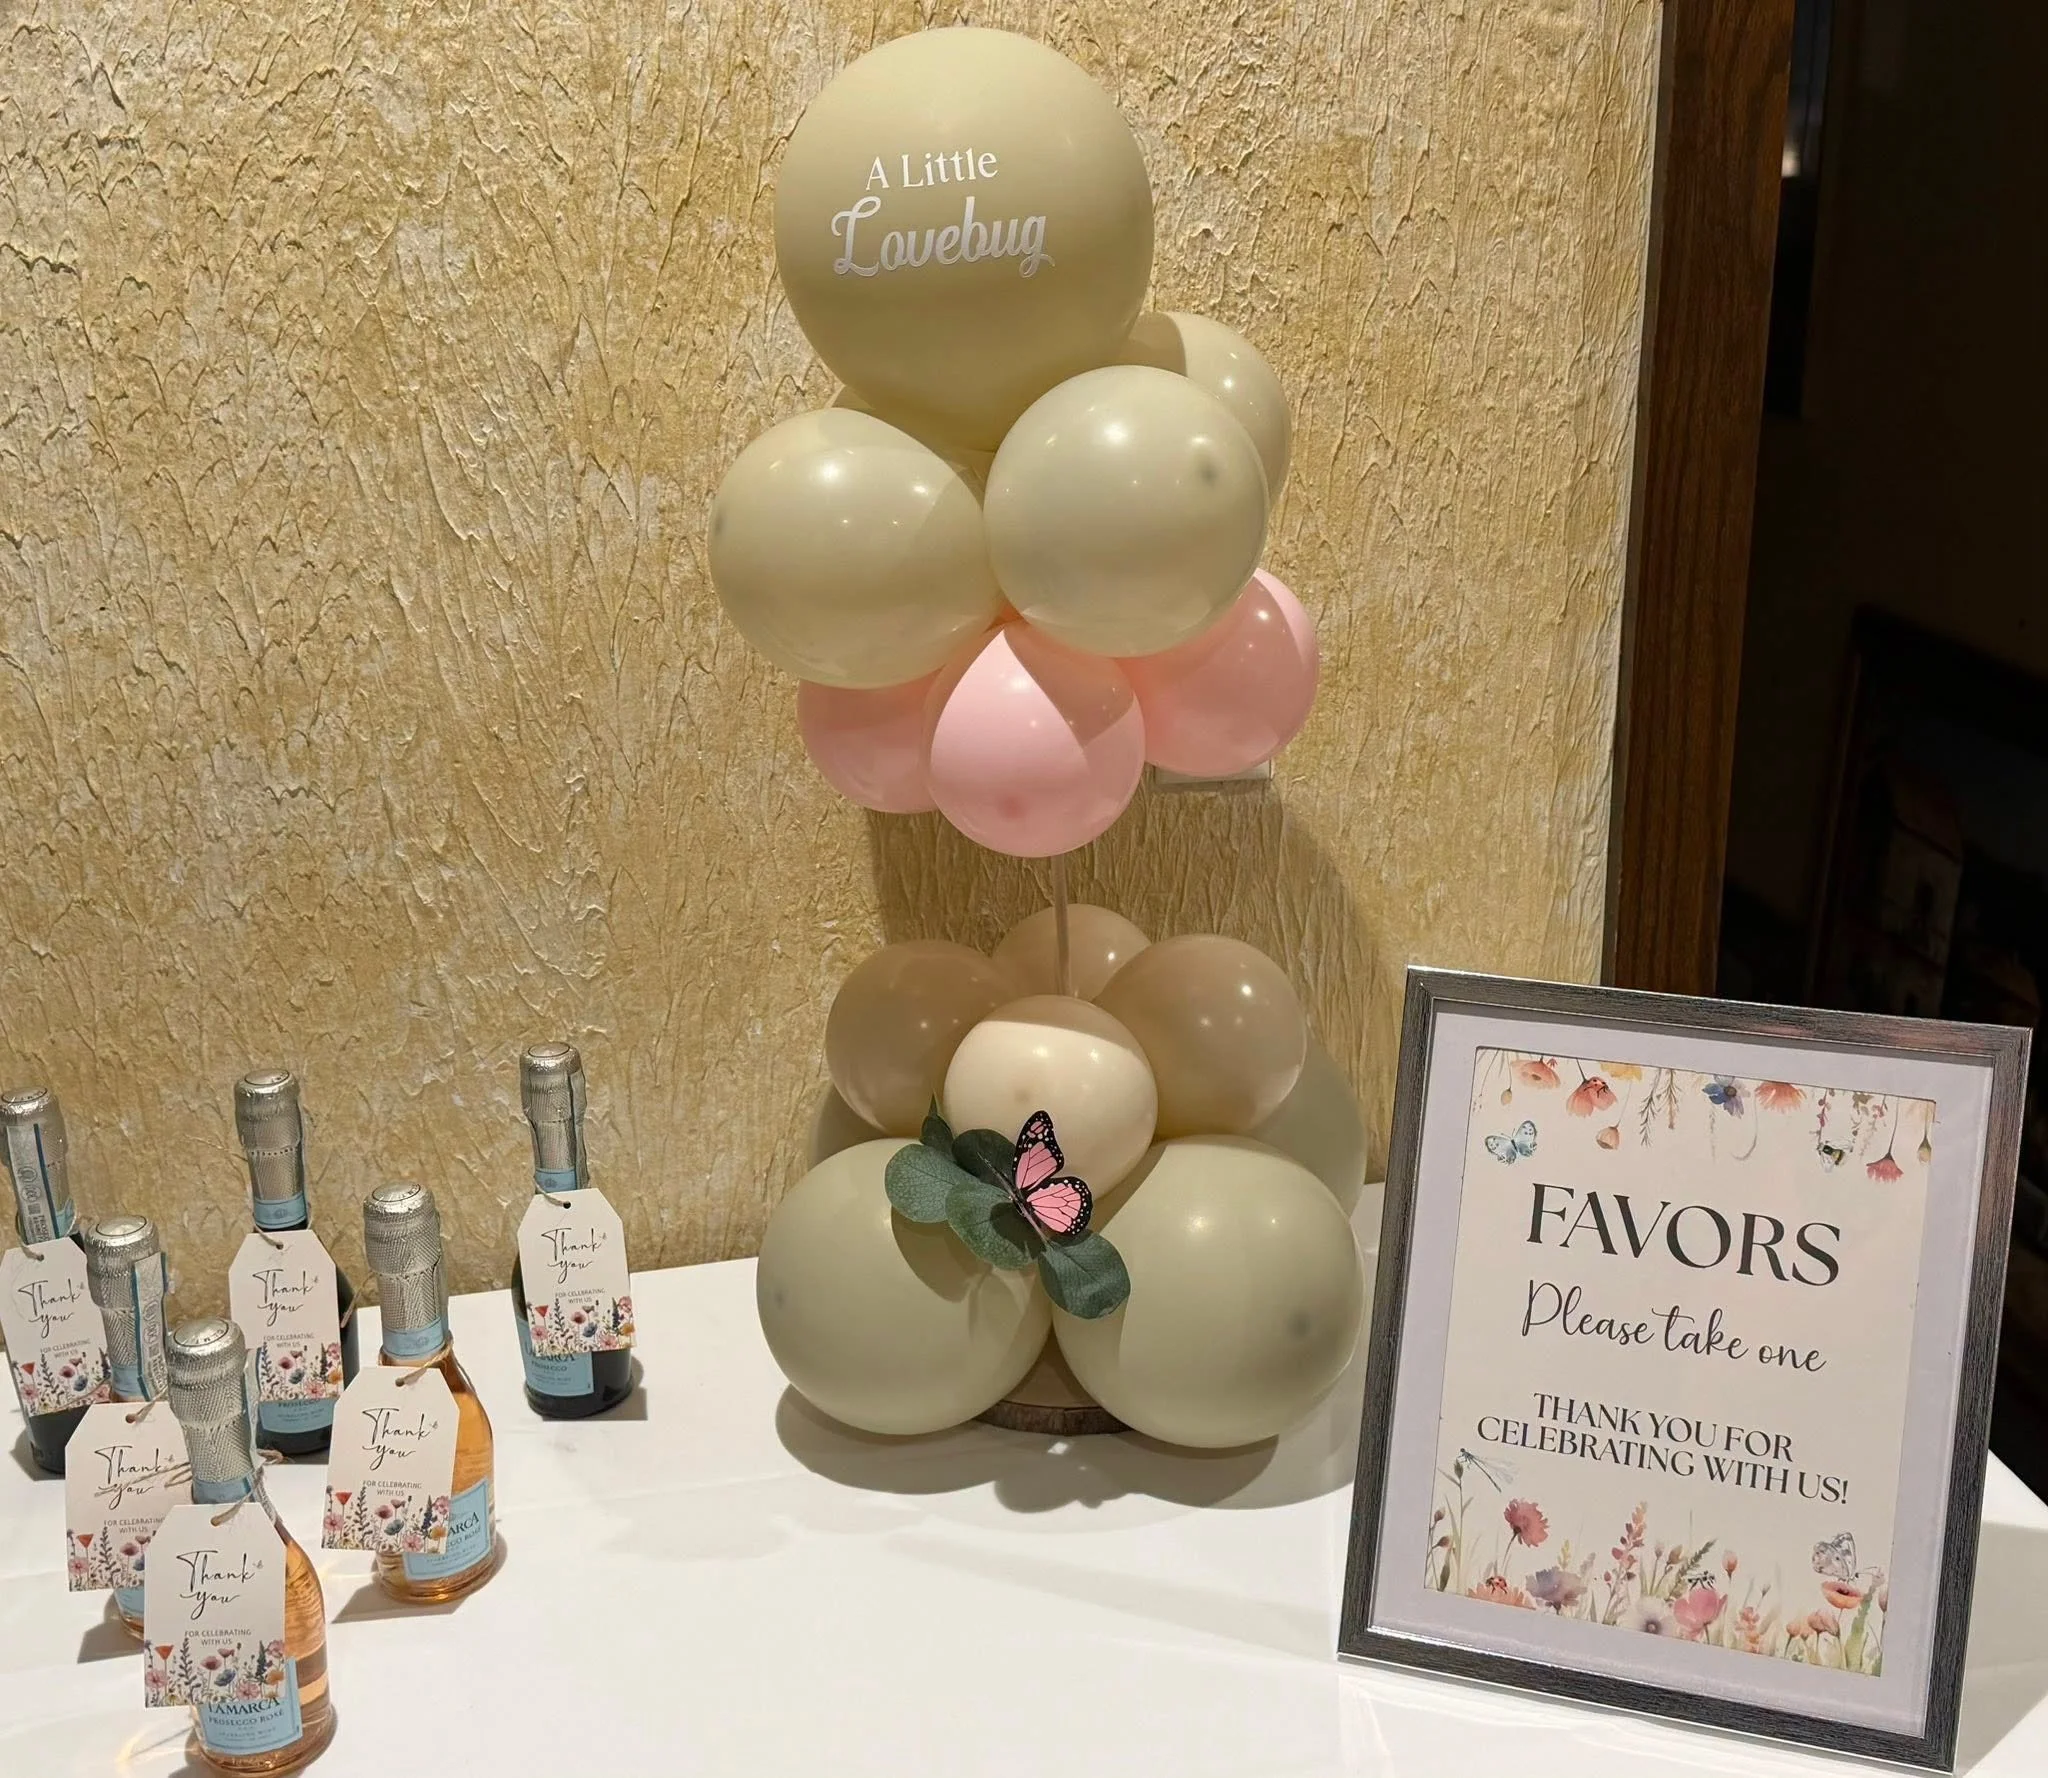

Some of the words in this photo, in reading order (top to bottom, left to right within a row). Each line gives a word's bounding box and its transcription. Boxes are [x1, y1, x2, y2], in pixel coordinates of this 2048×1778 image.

[865, 156, 890, 190] A
[901, 147, 999, 188] Little
[831, 196, 1056, 279] Lovebug
[541, 1227, 602, 1262] Thank
[1525, 1182, 1841, 1287] FAVORS
[252, 1268, 314, 1305] Thank
[547, 1260, 593, 1285] you
[18, 1278, 81, 1317] Thank
[257, 1302, 304, 1327] you
[28, 1311, 75, 1339] you
[1521, 1279, 1655, 1346] Please
[1650, 1305, 1749, 1361] take
[1758, 1343, 1827, 1374] one
[362, 1407, 431, 1446] Thank
[1533, 1393, 1640, 1435] THANK
[1649, 1412, 1718, 1449] YOU
[1724, 1427, 1794, 1463] FOR
[94, 1445, 165, 1485] Thank
[362, 1444, 416, 1471] you
[1476, 1417, 1695, 1477] CELEBRATING
[1702, 1455, 1790, 1495] WITH
[1797, 1473, 1849, 1506] US!
[98, 1483, 154, 1511] you
[362, 1480, 377, 1488] FOR
[377, 1481, 423, 1490] CELEBRATING
[395, 1489, 405, 1497] US
[119, 1517, 165, 1526] CELEBRATIN
[176, 1550, 255, 1592] Thank
[180, 1591, 240, 1620] you
[184, 1630, 199, 1638] FOR
[201, 1628, 252, 1638] CELEBRATING
